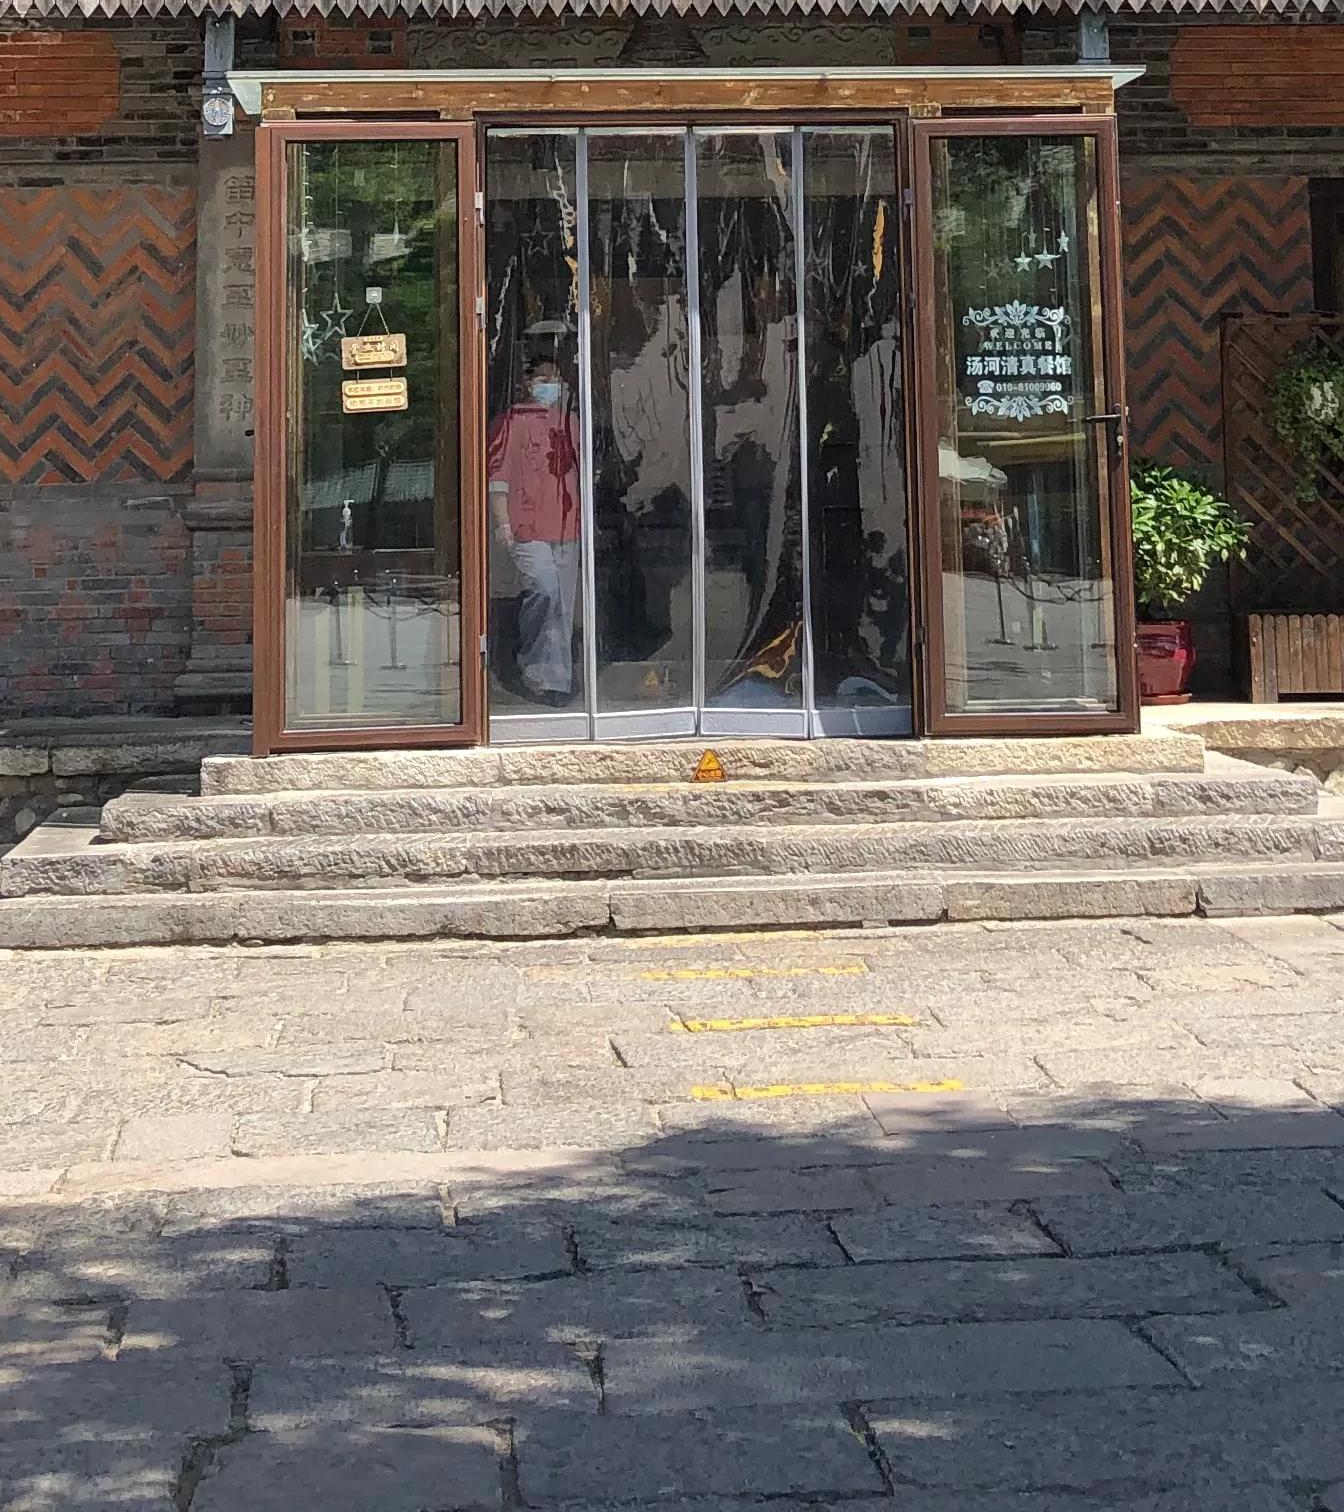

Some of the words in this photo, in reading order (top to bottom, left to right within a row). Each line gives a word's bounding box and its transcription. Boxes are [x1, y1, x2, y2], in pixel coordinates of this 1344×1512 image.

[982, 340, 1053, 351] WELCOME
[966, 355, 1072, 376] 汤河清真餐馆
